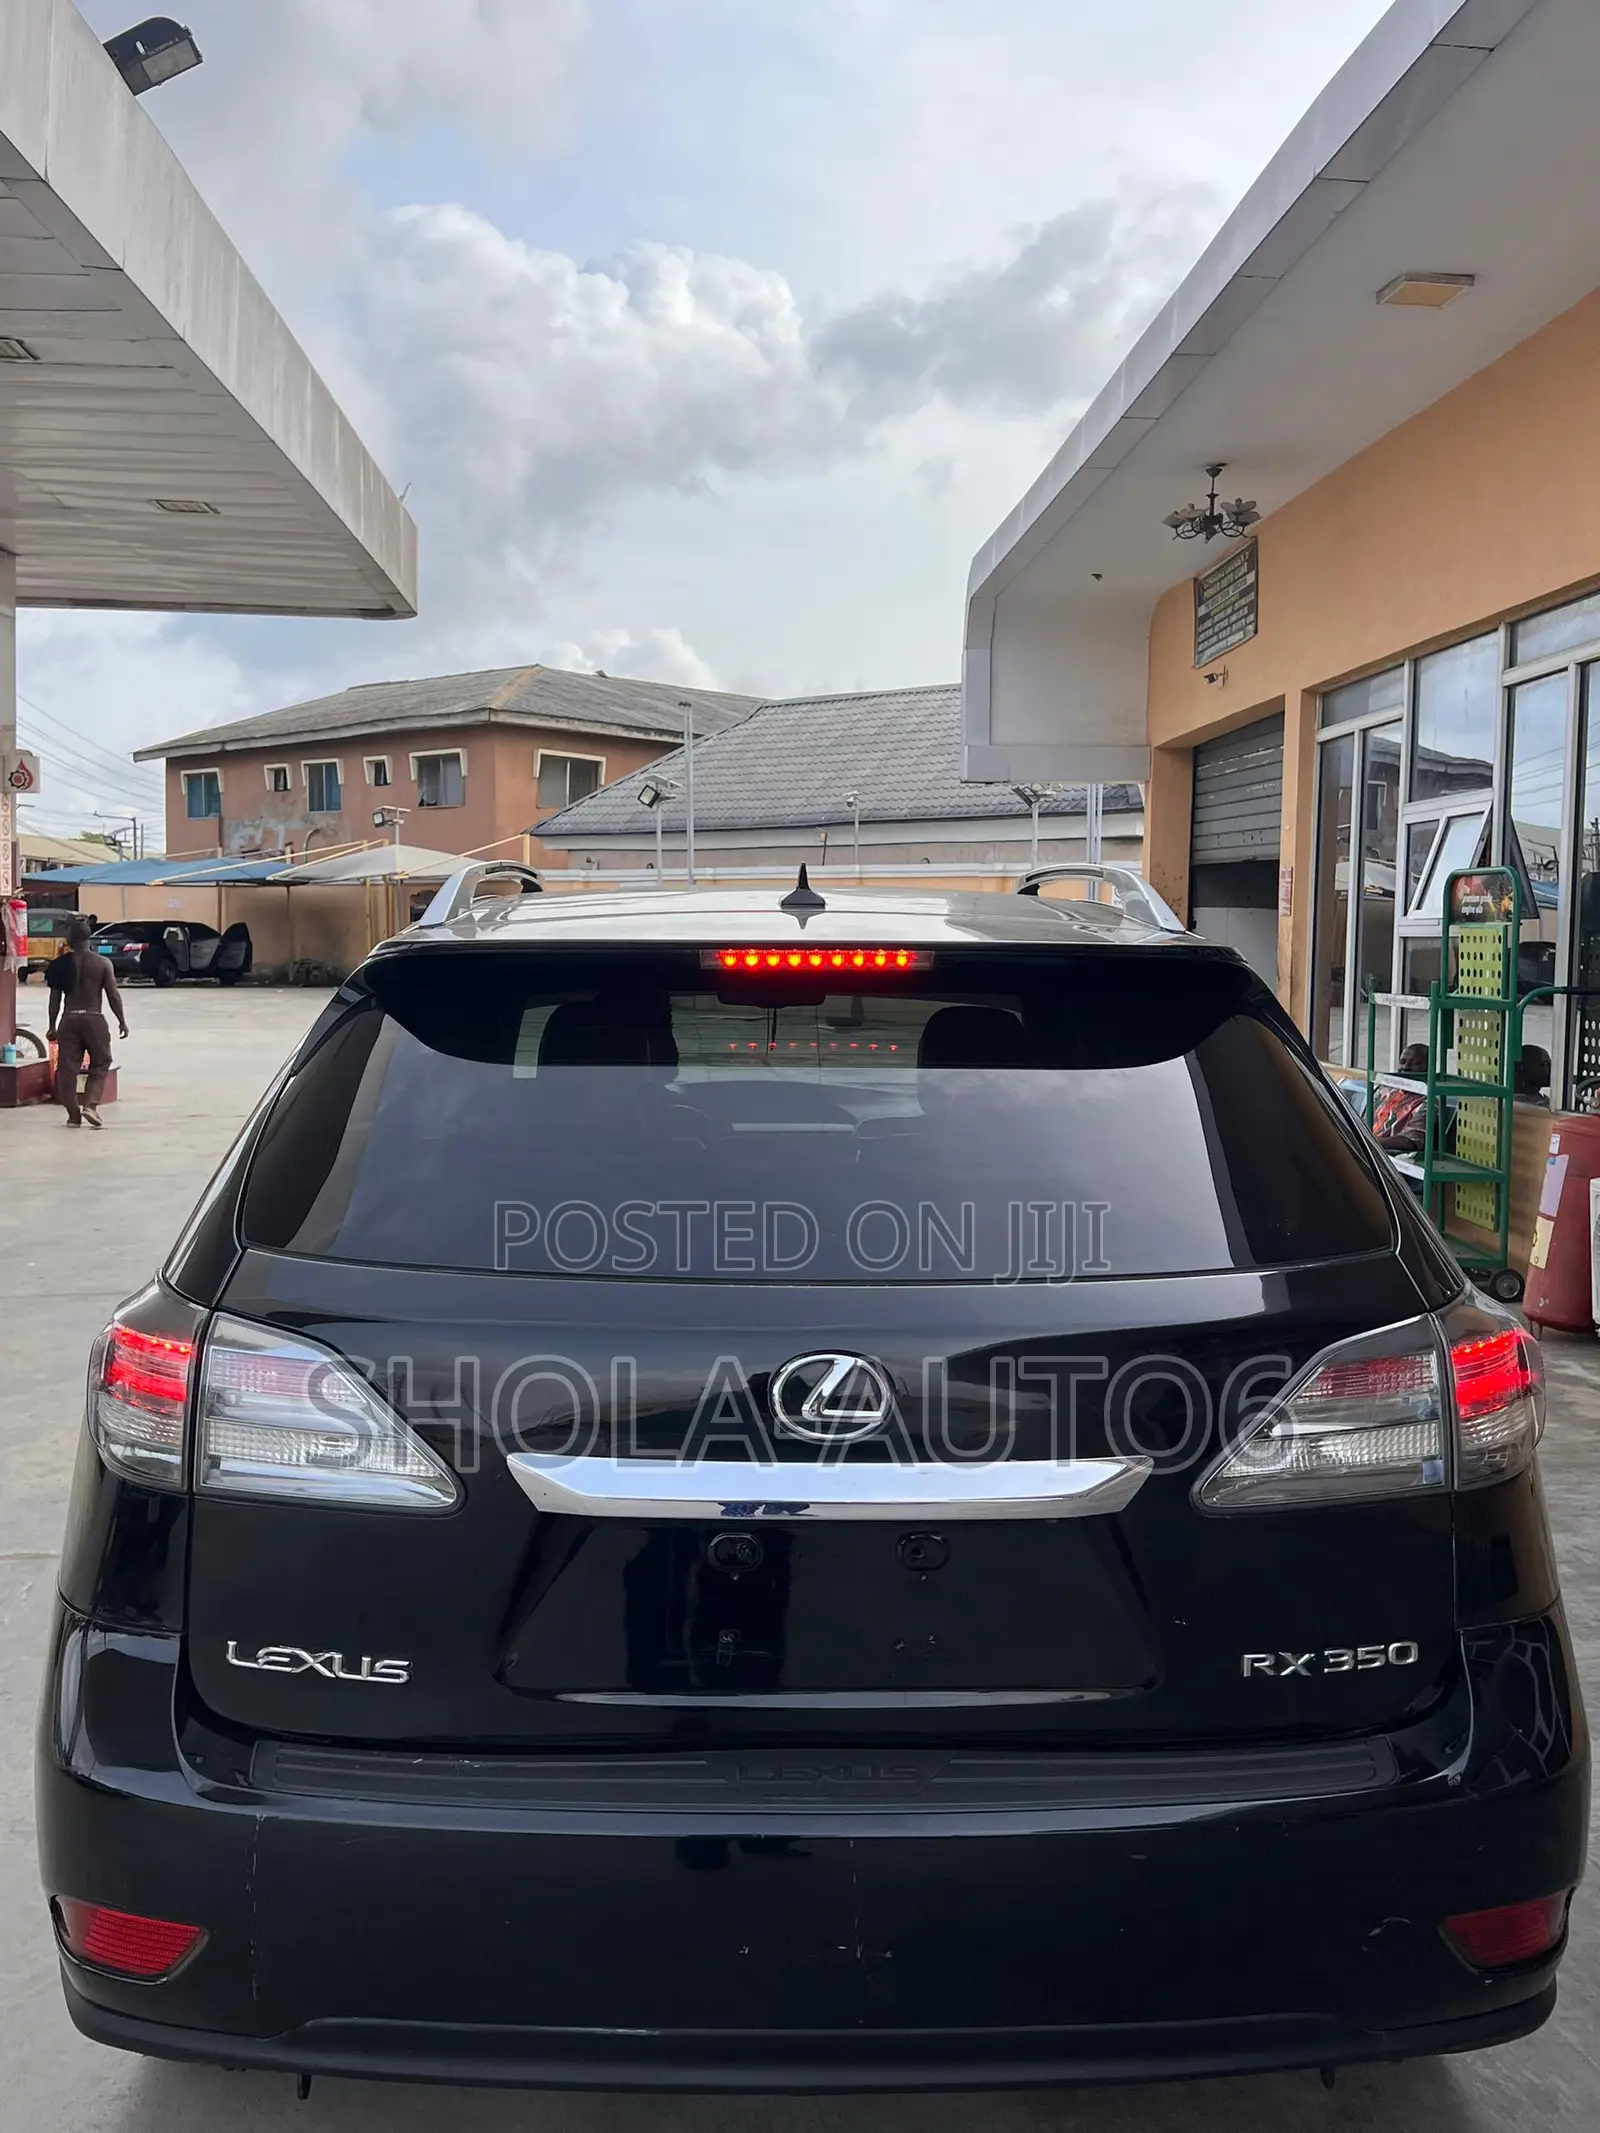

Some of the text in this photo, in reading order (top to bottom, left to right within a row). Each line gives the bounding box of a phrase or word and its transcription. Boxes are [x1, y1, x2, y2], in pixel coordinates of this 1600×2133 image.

[226, 1640, 411, 1684] LEXUS
[1241, 1640, 1419, 1678] RX 350
[736, 1762, 923, 1788] LEXUS
